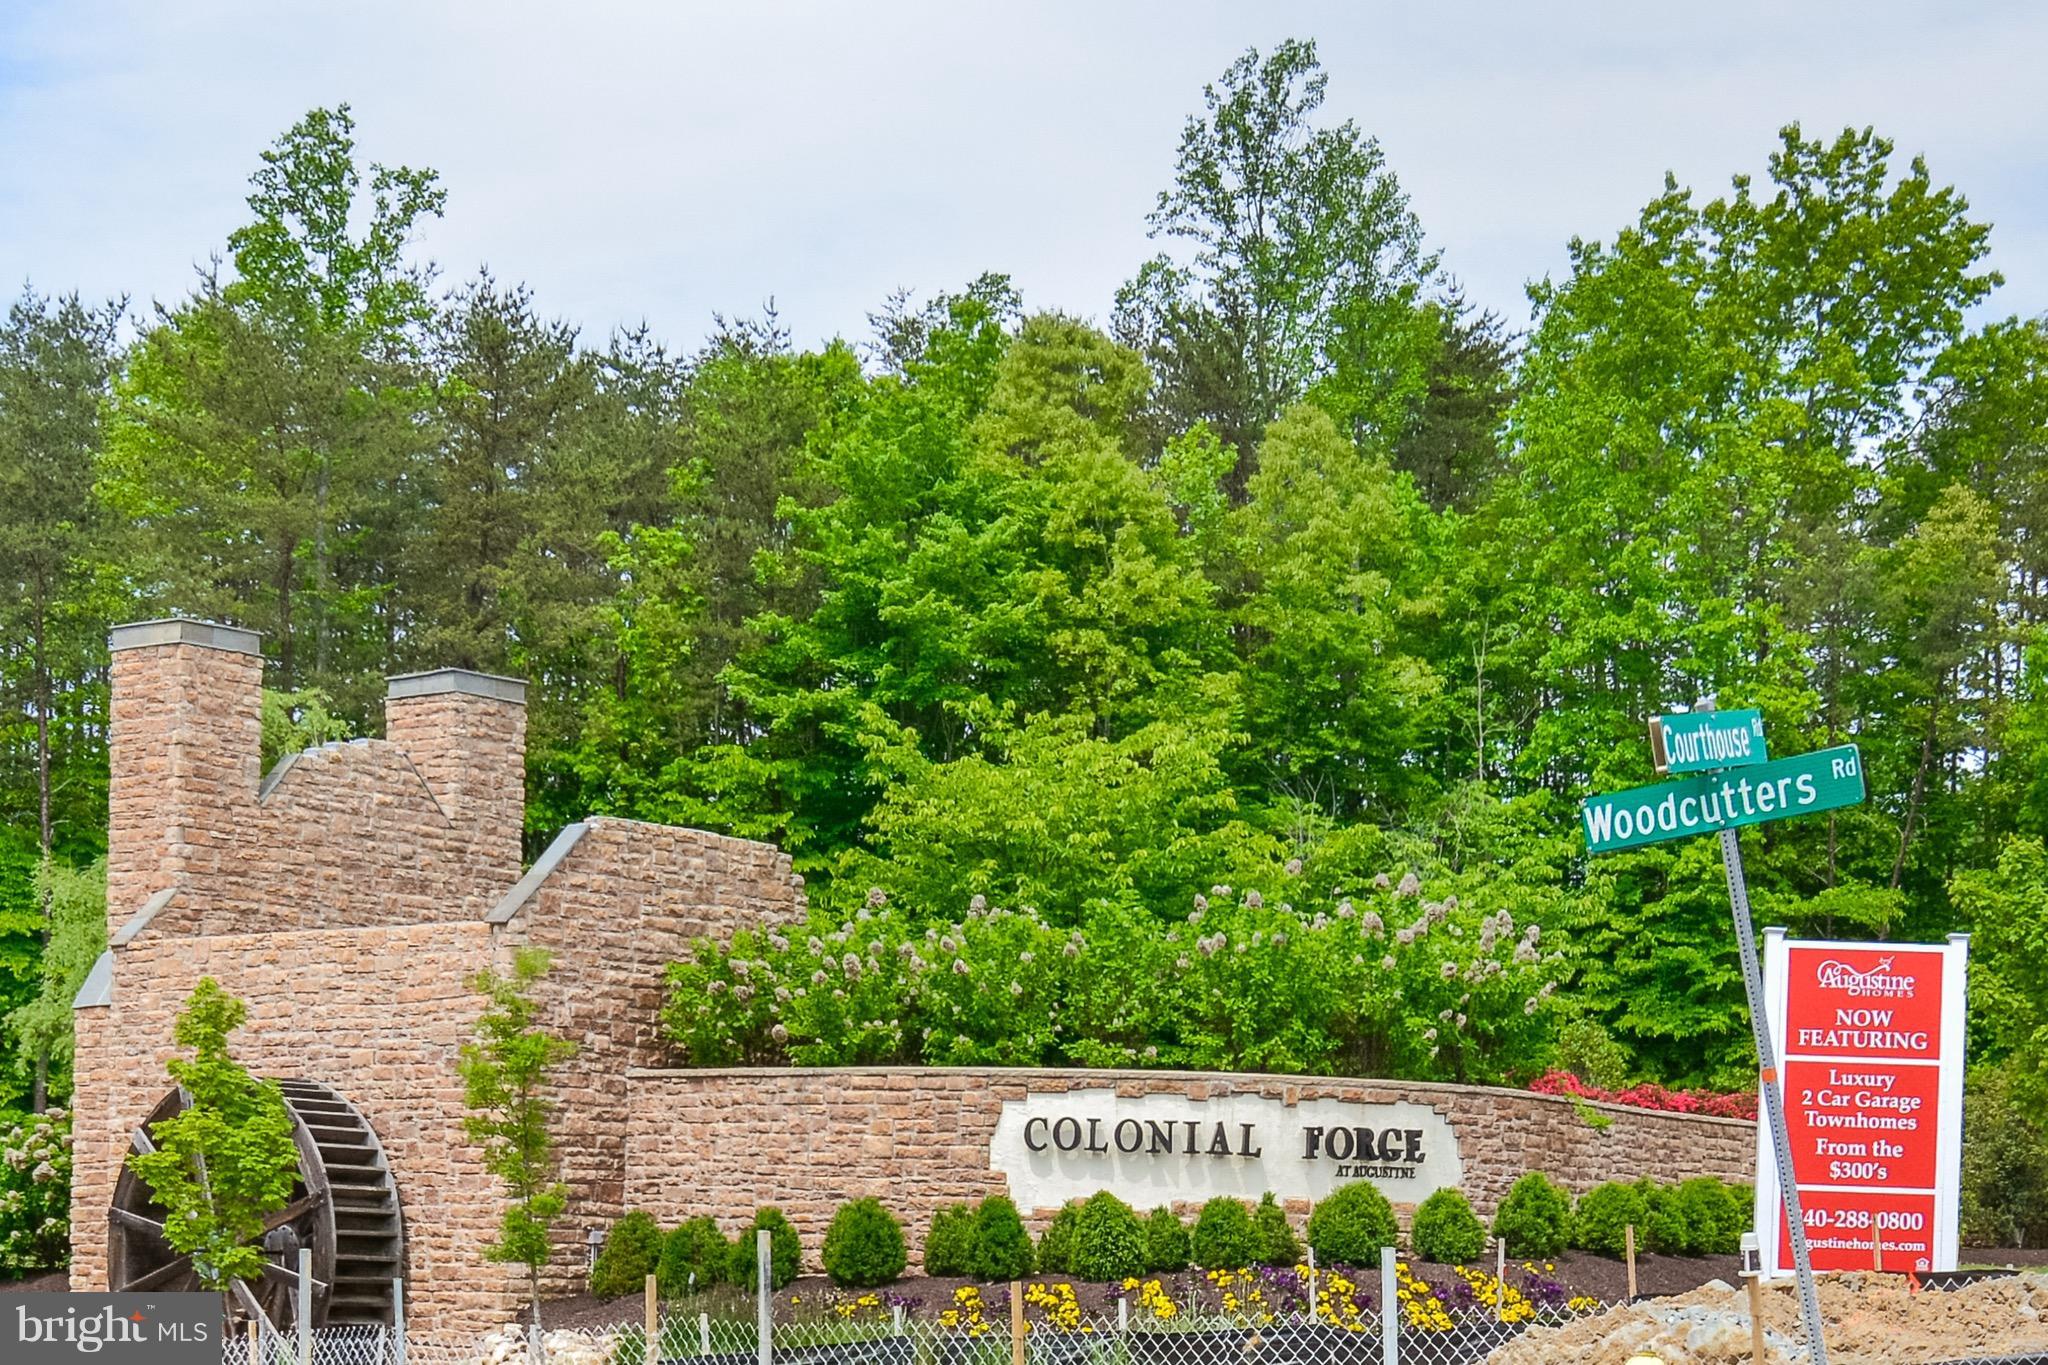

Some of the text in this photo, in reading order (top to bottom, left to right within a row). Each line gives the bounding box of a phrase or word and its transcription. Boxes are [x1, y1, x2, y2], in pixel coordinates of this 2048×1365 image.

[1663, 717, 1764, 765] Courthouse Rd
[1584, 756, 1857, 844] Woodcutters Rd
[1817, 959, 1915, 996] Augustine
[1862, 989, 1914, 998] HOMES
[1835, 1009, 1893, 1027] NOW
[1798, 1029, 1928, 1050] FEATURING
[1829, 1069, 1895, 1090] Luxury
[1801, 1090, 1921, 1113] 2 Car Garage
[1804, 1110, 1917, 1130] Townhomes
[1023, 1116, 1426, 1164] COLONIAL FORGE
[1815, 1138, 1904, 1158] From the
[1335, 1164, 1416, 1179] AT AUGUSTINE
[1829, 1161, 1888, 1180] $300's
[1800, 1209, 1923, 1231] 40-288-0800
